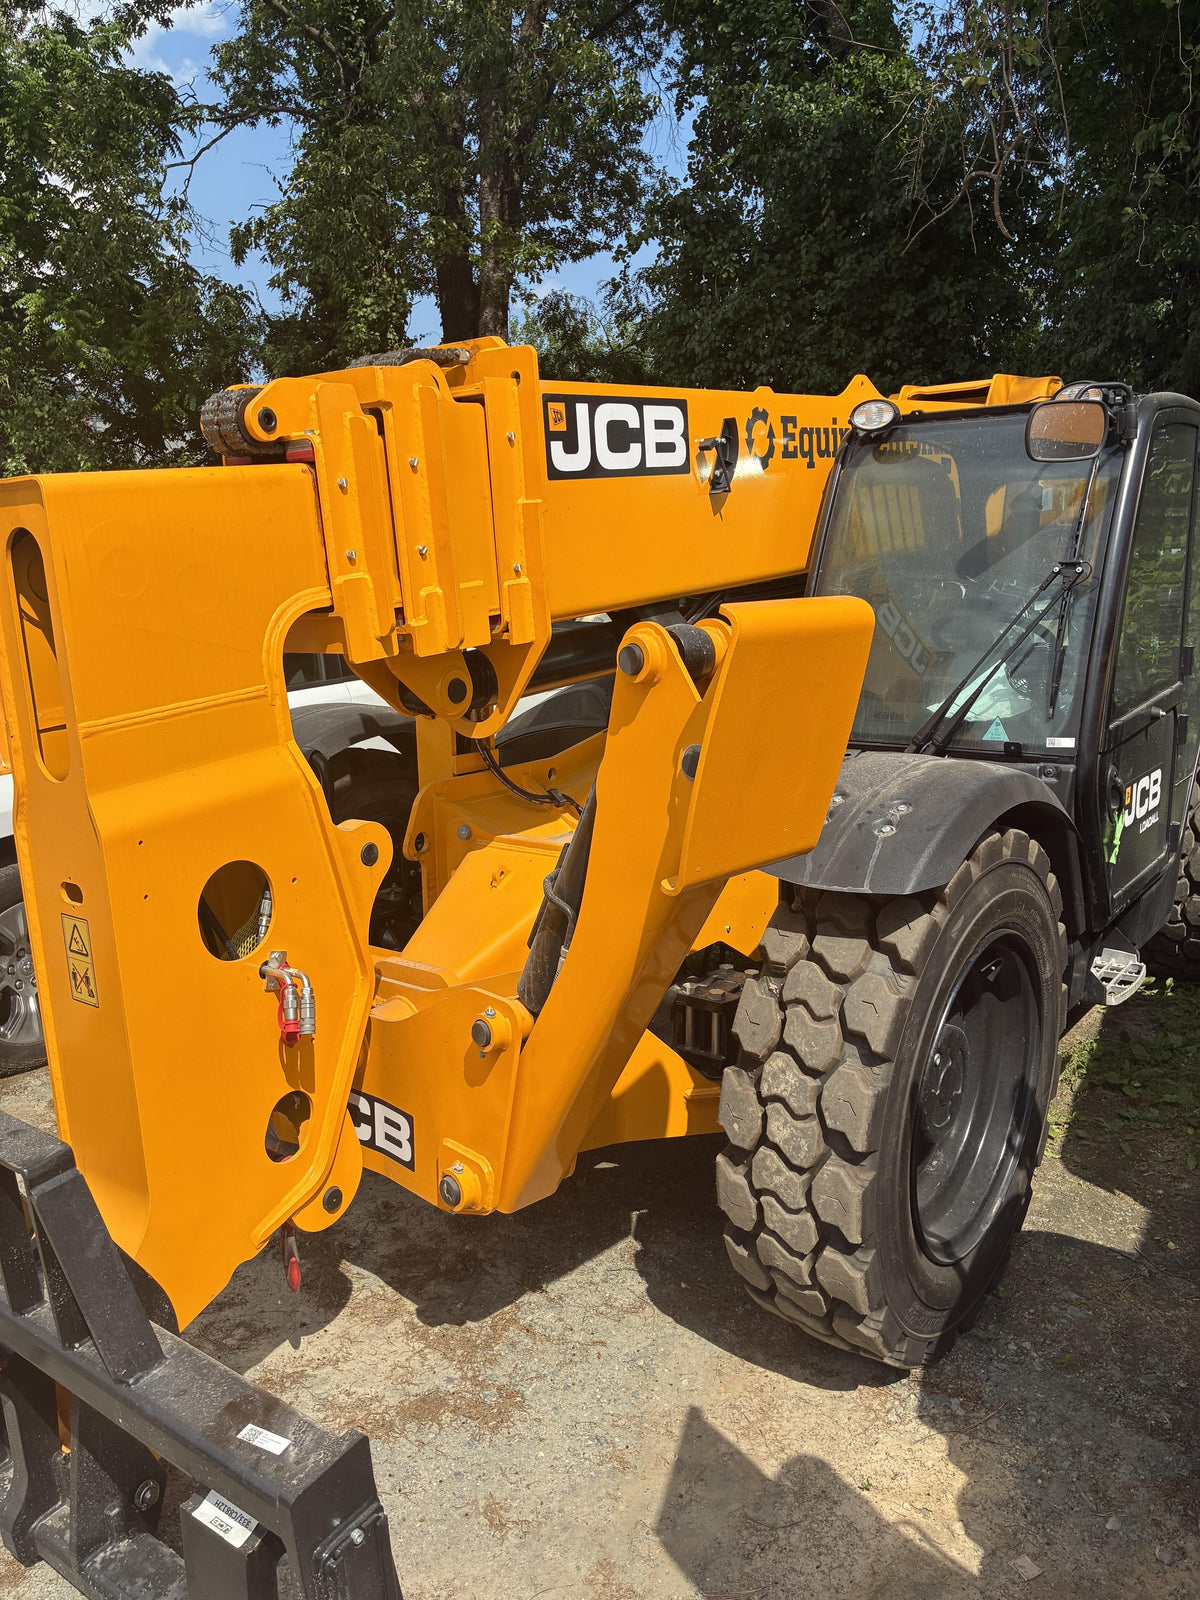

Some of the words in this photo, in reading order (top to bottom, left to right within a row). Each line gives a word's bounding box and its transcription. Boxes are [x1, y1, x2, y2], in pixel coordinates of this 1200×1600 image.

[549, 402, 688, 472] JCB
[1124, 767, 1162, 828] JCB
[347, 1092, 412, 1162] CB
[210, 1516, 233, 1535] JCB
